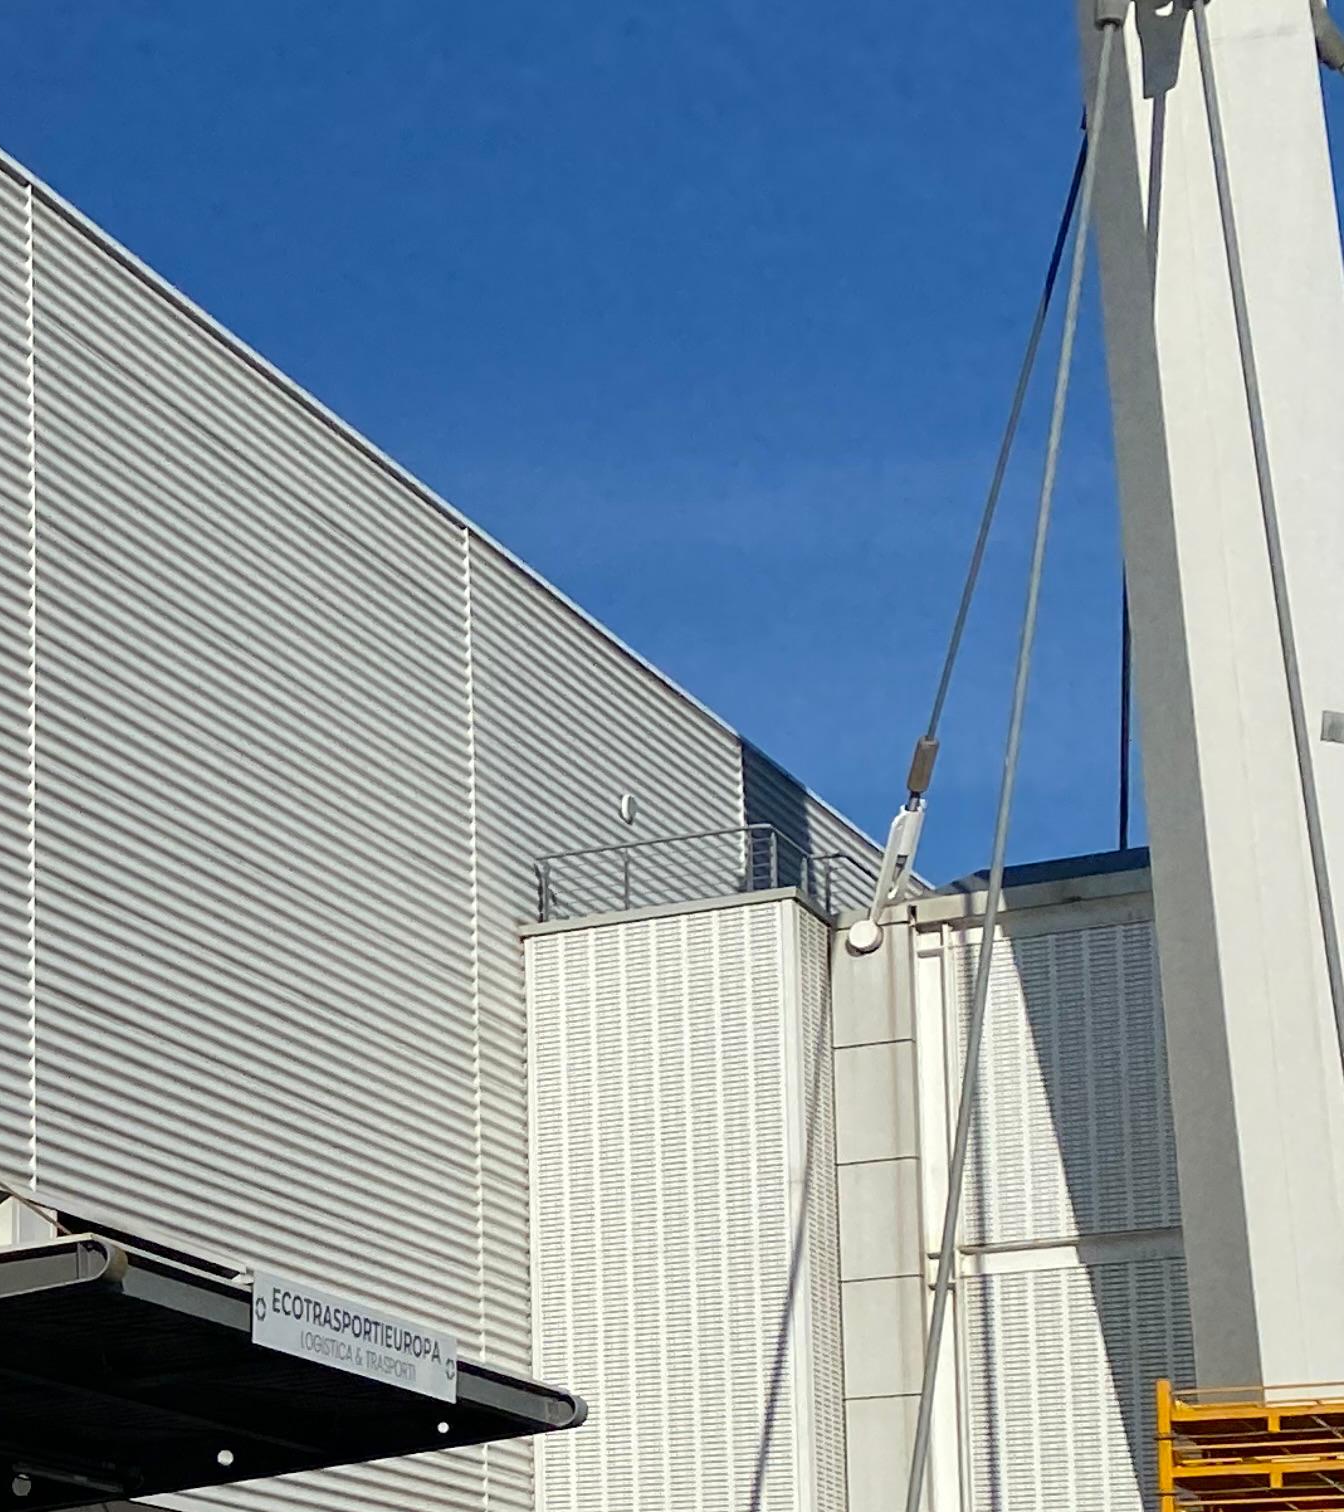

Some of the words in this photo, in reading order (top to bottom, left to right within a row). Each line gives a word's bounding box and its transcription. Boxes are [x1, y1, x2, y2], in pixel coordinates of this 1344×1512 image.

[271, 1286, 442, 1365] ECOTRASPORTIEUROPA
[300, 1330, 354, 1363] LOGISTICA
[365, 1349, 417, 1382] TRASPORTI
